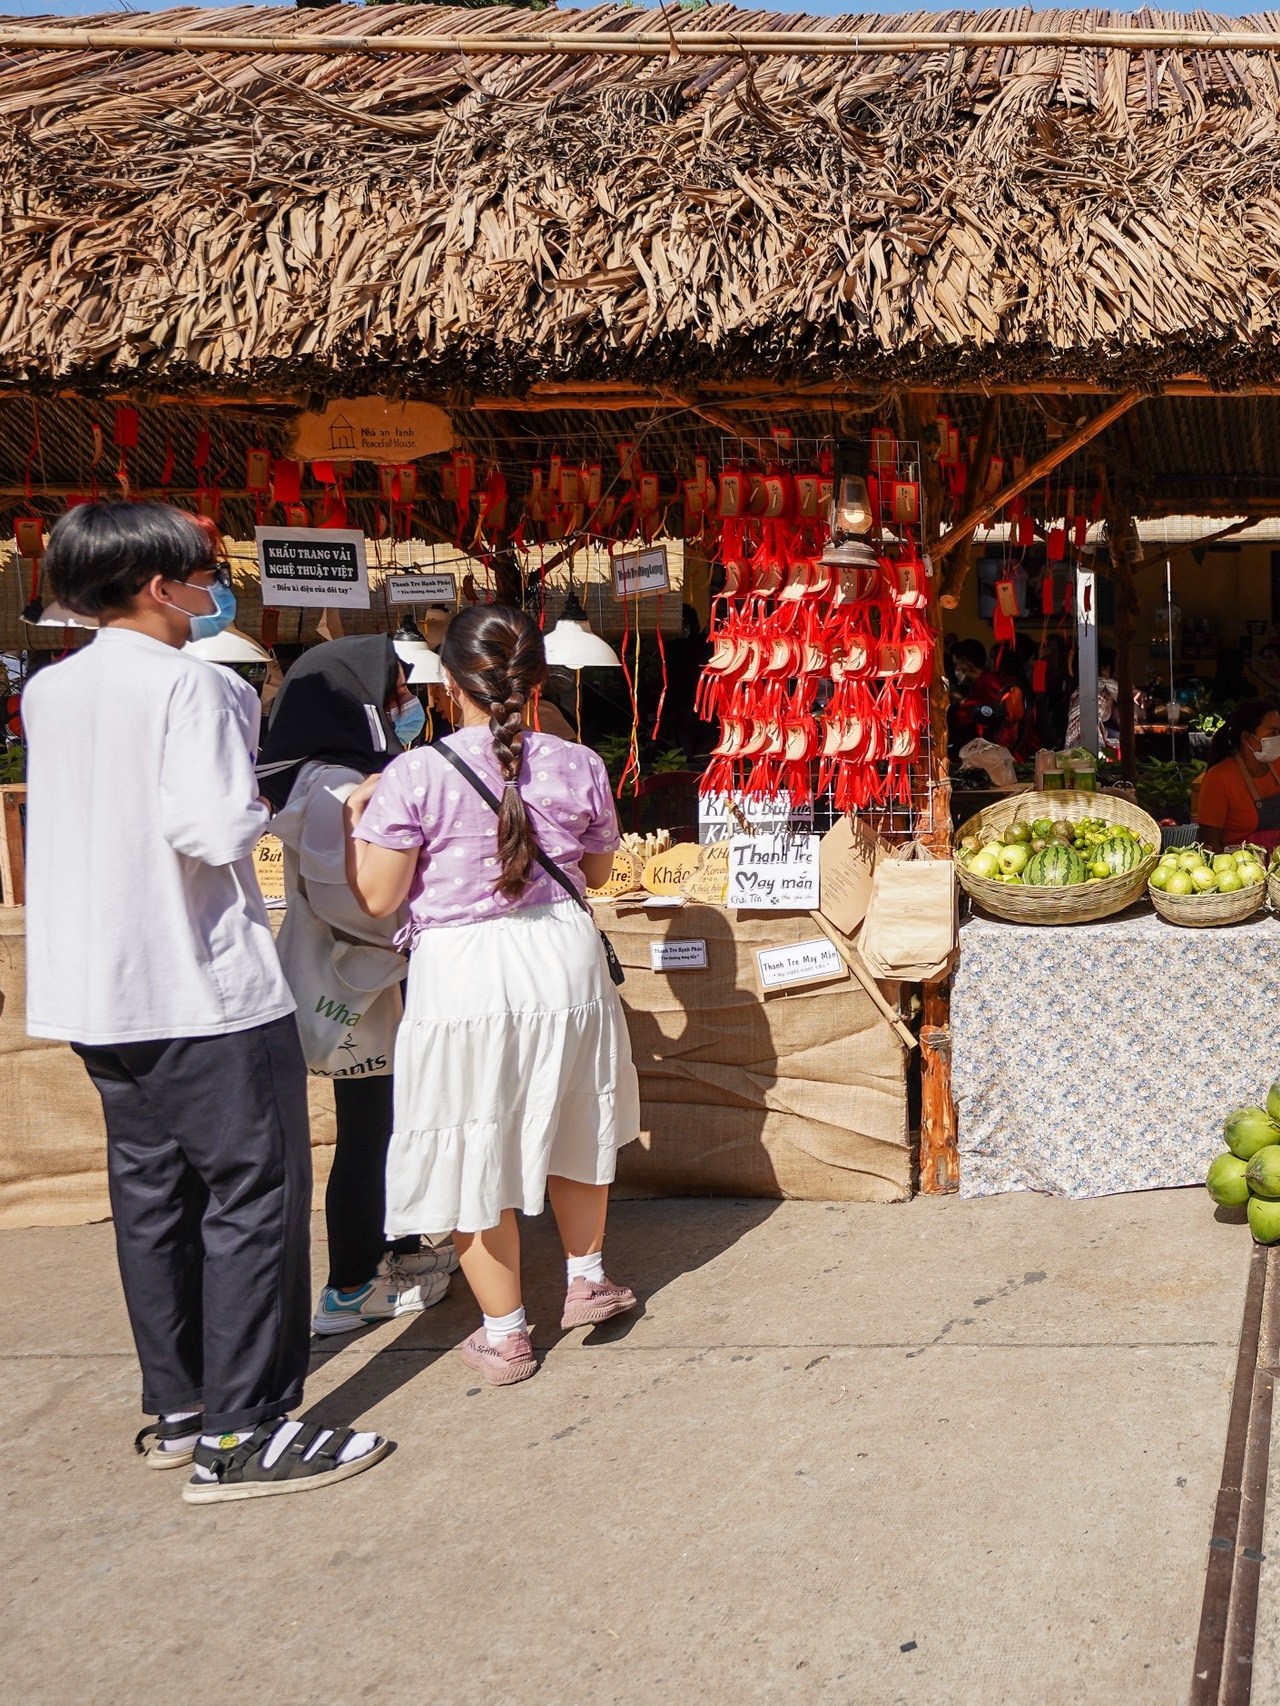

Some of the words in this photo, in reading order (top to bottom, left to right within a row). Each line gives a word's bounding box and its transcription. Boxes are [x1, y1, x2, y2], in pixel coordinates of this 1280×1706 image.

[361, 438, 392, 448] Peaceful
[393, 439, 416, 448] House
[268, 543, 296, 558] KHẨU
[298, 549, 331, 560] TRANG
[332, 547, 351, 561] VẢI
[269, 563, 295, 576] NGHỆ
[296, 564, 329, 578] THUẬT
[331, 565, 354, 579] VIỆT
[733, 843, 787, 866] Thanh
[791, 844, 813, 864] Tre
[735, 871, 775, 896] May
[780, 871, 813, 889] mắn
[763, 961, 784, 971] Thanh
[787, 958, 799, 967] Tre
[802, 955, 817, 964] May
[309, 1054, 387, 1076] wants
